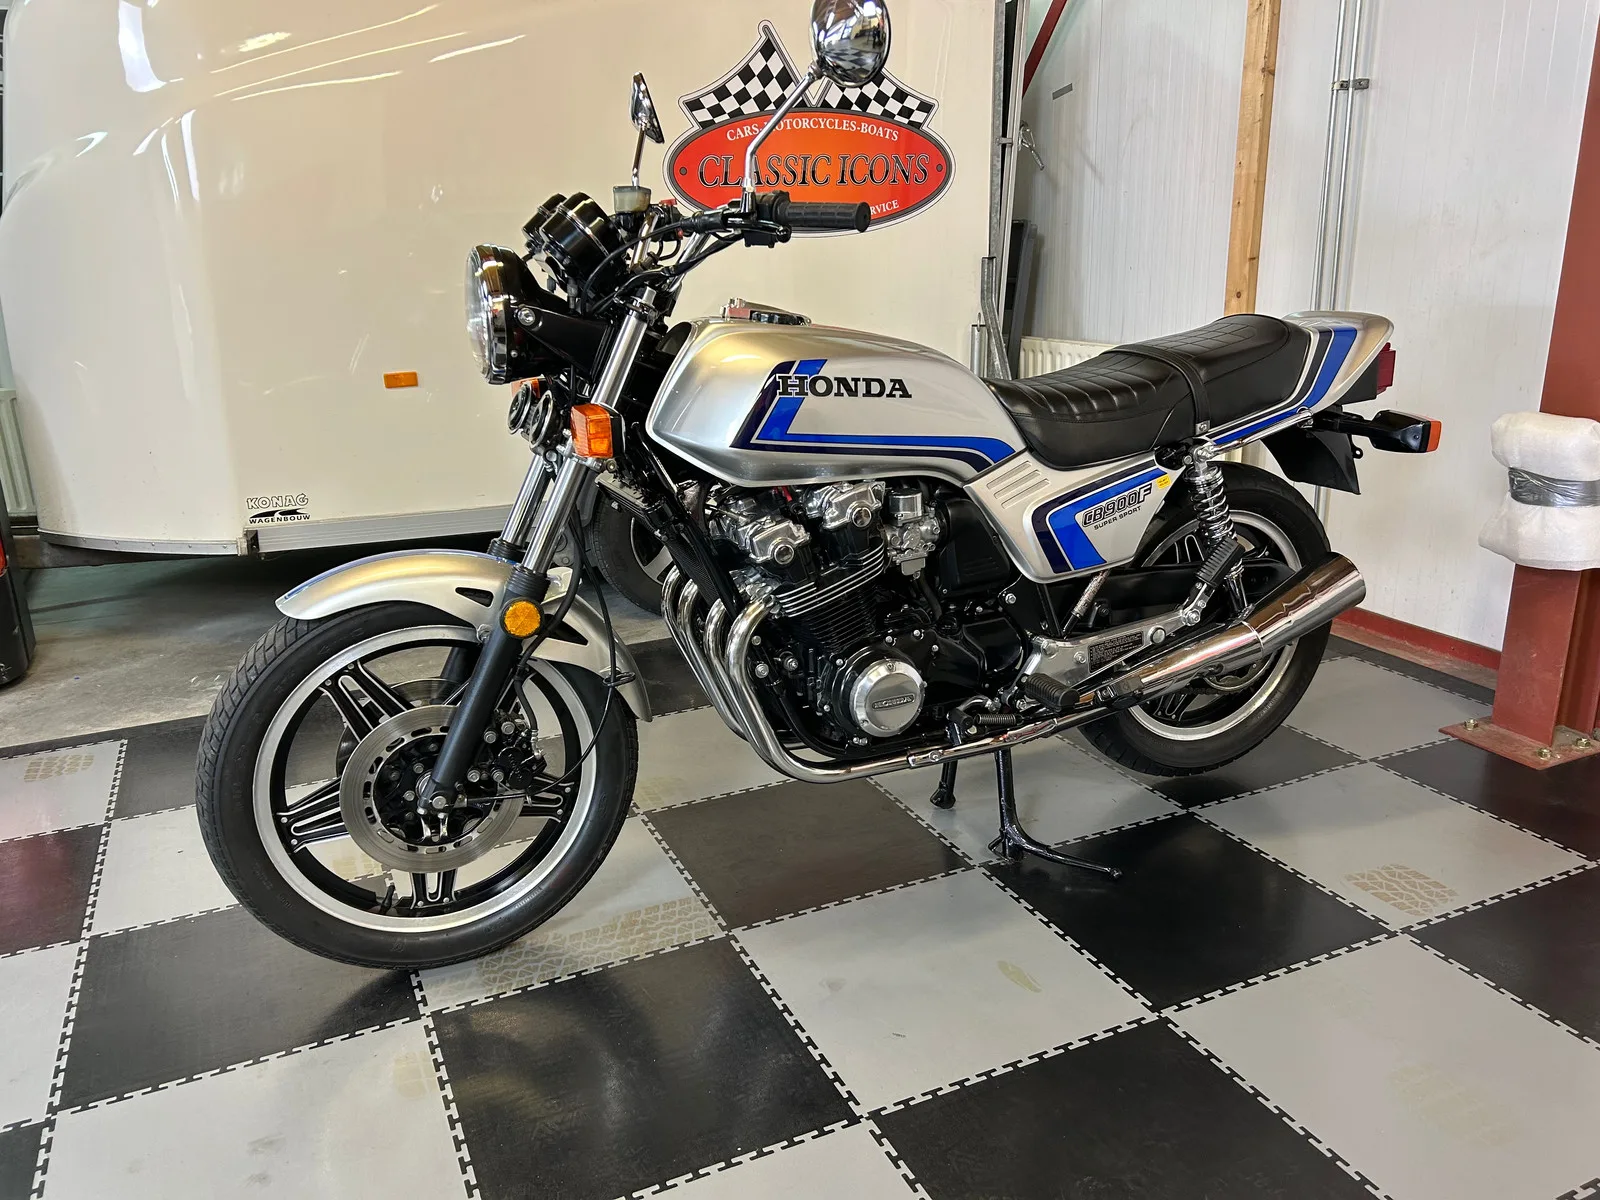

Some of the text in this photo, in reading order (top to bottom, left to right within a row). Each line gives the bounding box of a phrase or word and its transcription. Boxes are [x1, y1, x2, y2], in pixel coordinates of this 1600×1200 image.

[837, 153, 930, 186] ICONS
[869, 199, 900, 215] RVICE
[776, 375, 913, 399] HONDA
[246, 493, 309, 509] KONAG
[1082, 482, 1153, 527] CB900F
[249, 514, 311, 524] WAGENBOUW
[1093, 506, 1141, 530] SUPER SPORT
